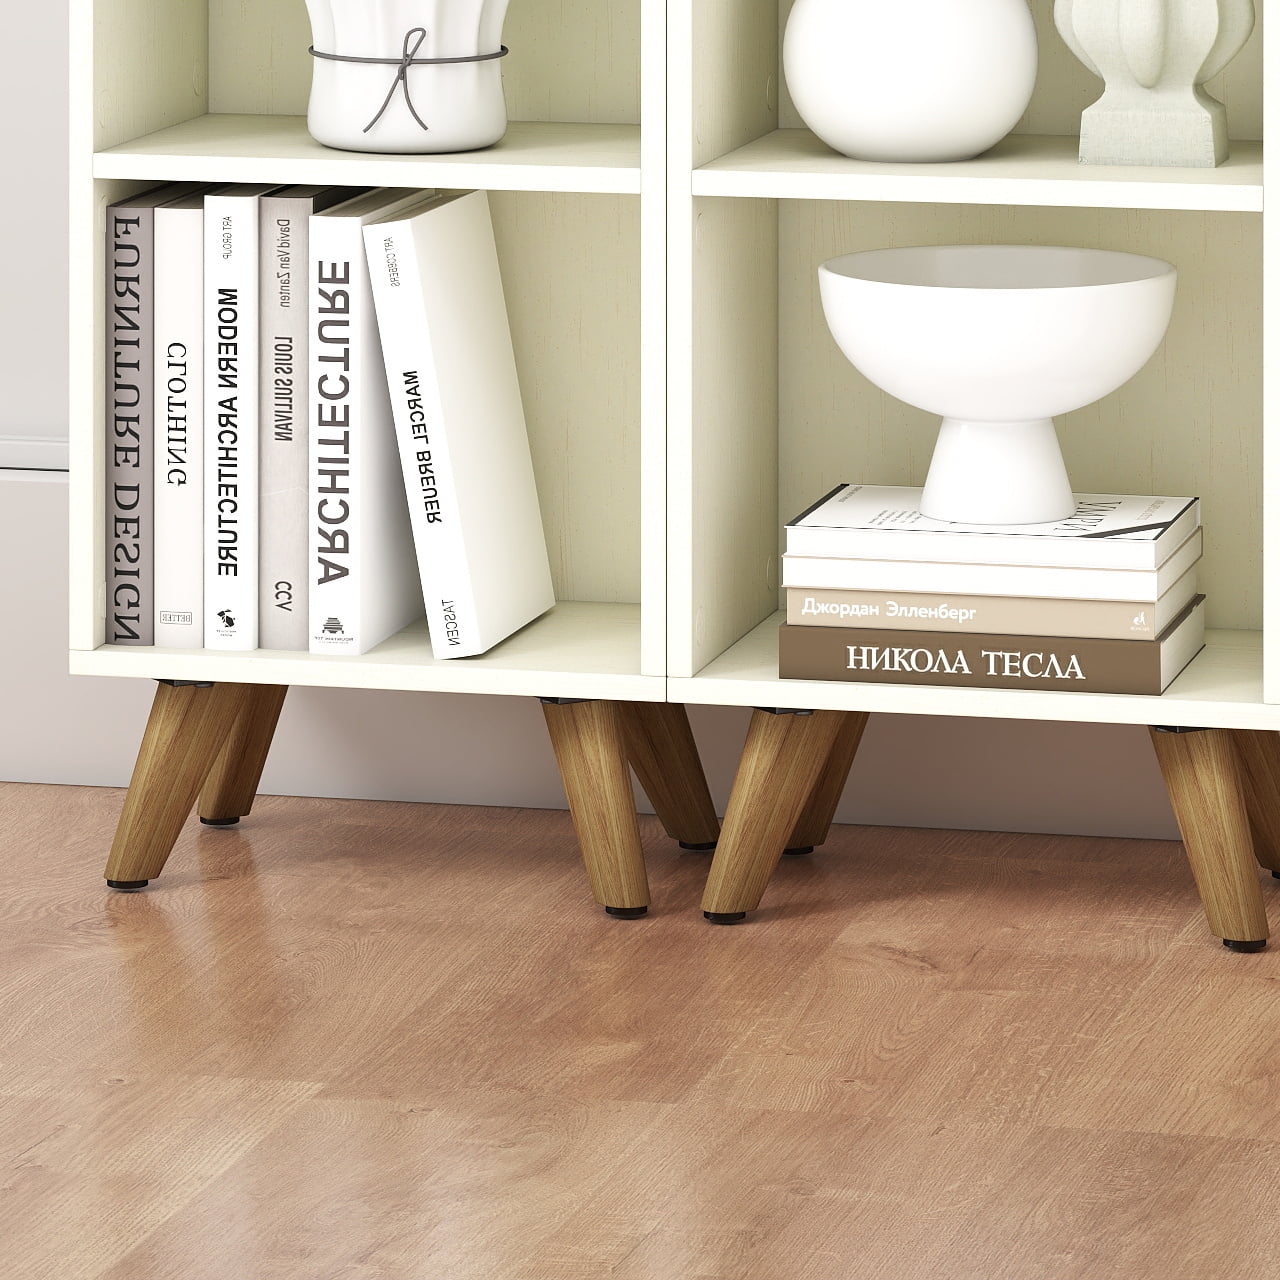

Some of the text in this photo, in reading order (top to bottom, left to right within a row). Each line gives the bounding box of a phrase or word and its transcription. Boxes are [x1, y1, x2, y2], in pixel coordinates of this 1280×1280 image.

[801, 597, 977, 623] Джордан Элленберг
[846, 645, 1086, 680] НИКОЛА ТЕСЛА
